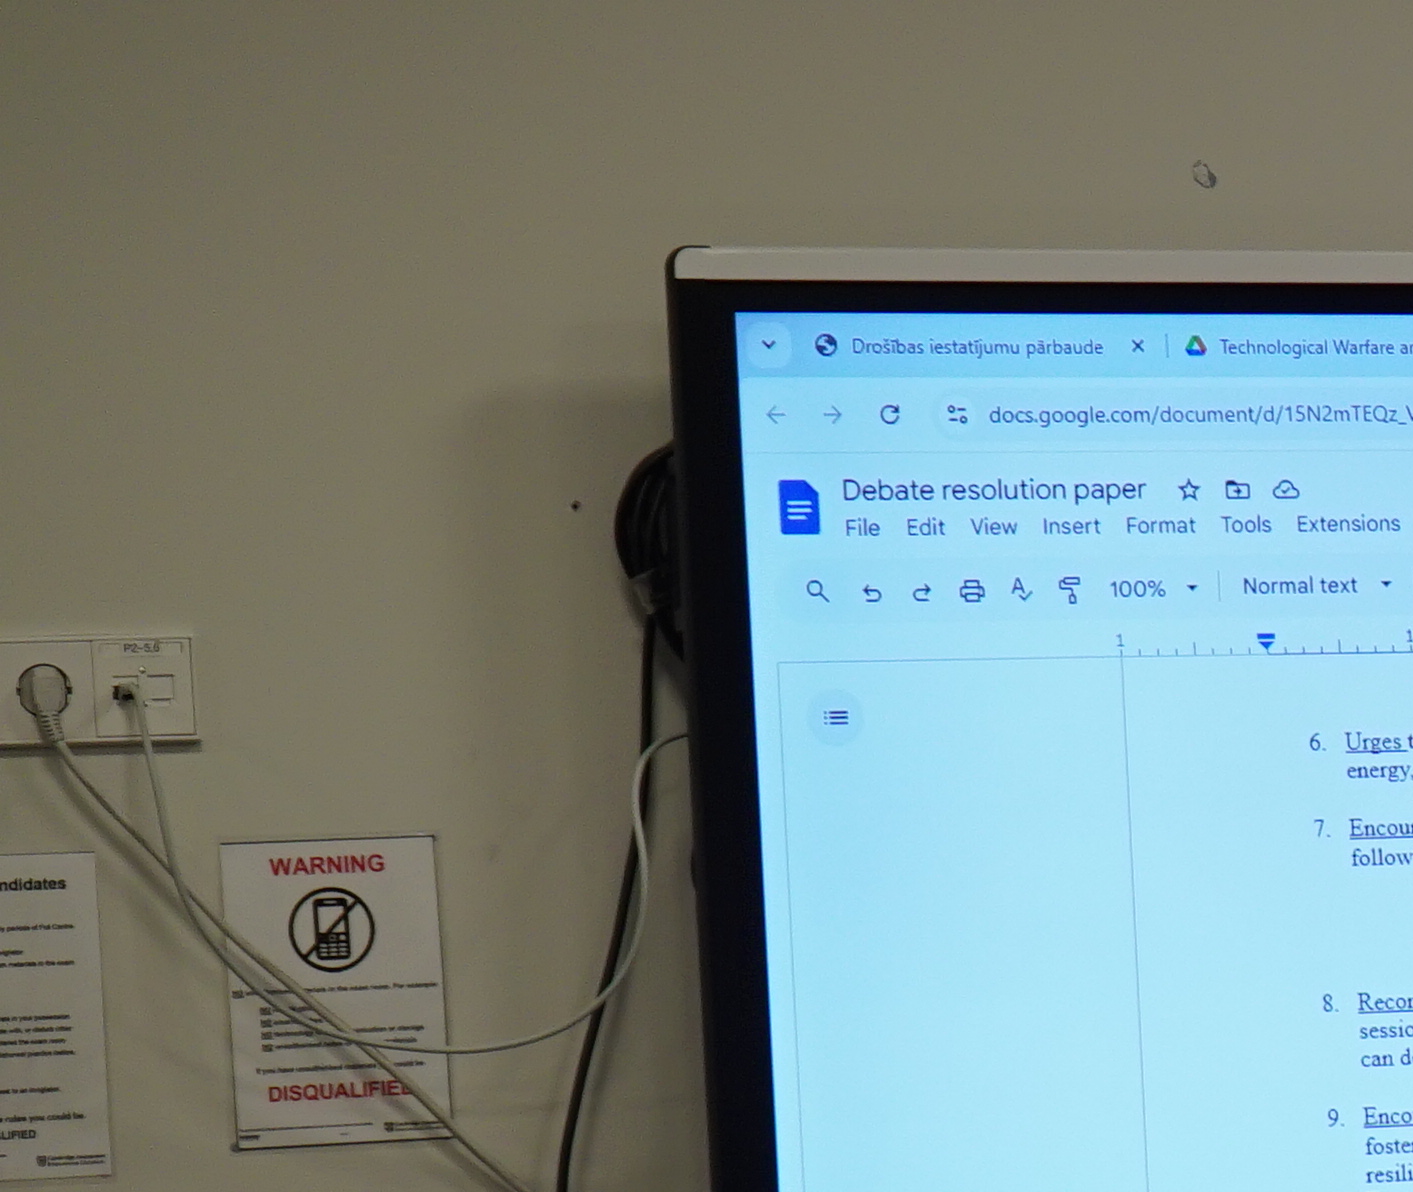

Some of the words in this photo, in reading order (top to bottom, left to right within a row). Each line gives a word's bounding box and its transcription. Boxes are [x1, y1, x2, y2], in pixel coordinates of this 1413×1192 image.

[929, 337, 1020, 360] iestatījumu
[1025, 338, 1104, 360] pārbaude
[1218, 338, 1328, 360] Technological
[1332, 338, 1395, 355] Warfare
[842, 478, 935, 502] Debate
[942, 477, 1067, 501] resolution
[1074, 482, 1147, 506] paper
[845, 517, 881, 537] File
[906, 516, 946, 537] Edit
[969, 516, 1018, 536] View
[1043, 517, 1101, 535] Insert
[1126, 516, 1197, 535] Format
[1220, 514, 1273, 534] Tools
[1297, 513, 1401, 533] Extensions
[1110, 579, 1167, 598] 100%
[1243, 575, 1314, 595] Normal
[1319, 577, 1358, 594] text
[1309, 731, 1328, 754] 6.
[1344, 730, 1403, 756] Urges
[1314, 818, 1331, 838] 7.
[268, 853, 387, 876] WARNING
